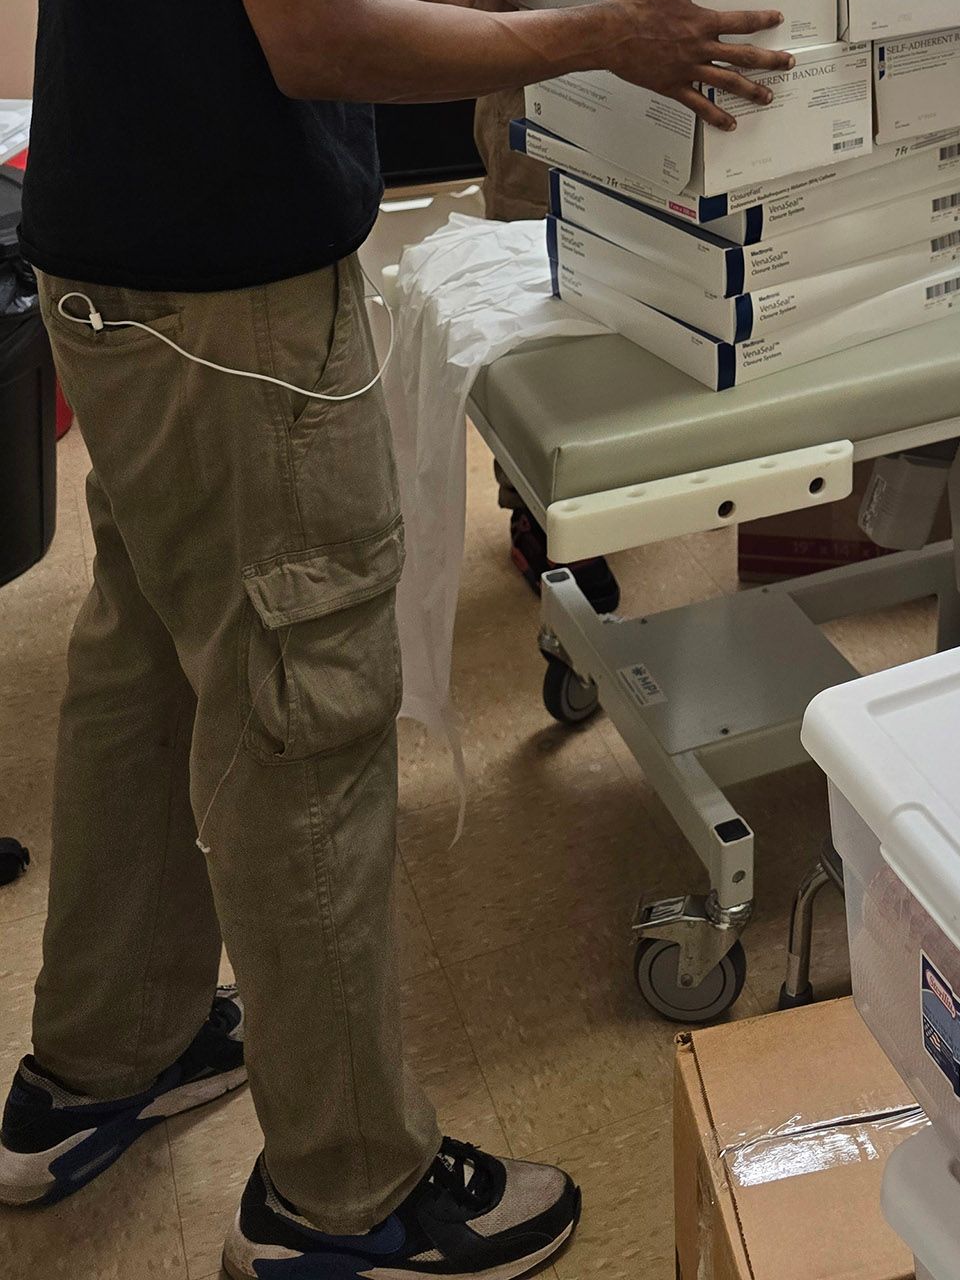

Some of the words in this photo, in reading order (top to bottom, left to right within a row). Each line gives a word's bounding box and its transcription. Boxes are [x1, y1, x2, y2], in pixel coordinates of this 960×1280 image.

[887, 33, 953, 55] SELF-ADHERENT
[792, 64, 837, 81] BANDAGE
[533, 101, 542, 116] 18
[895, 147, 901, 158] 7
[901, 145, 909, 155] Fr
[769, 211, 788, 222] Closure
[788, 206, 805, 217] System
[751, 265, 770, 276] Closure
[771, 260, 790, 271] System
[760, 310, 779, 321] Closure
[779, 305, 797, 315] System
[743, 357, 763, 368] Closure
[763, 352, 782, 362] System
[638, 676, 660, 696] MPI
[928, 974, 956, 1014] Sterilite
